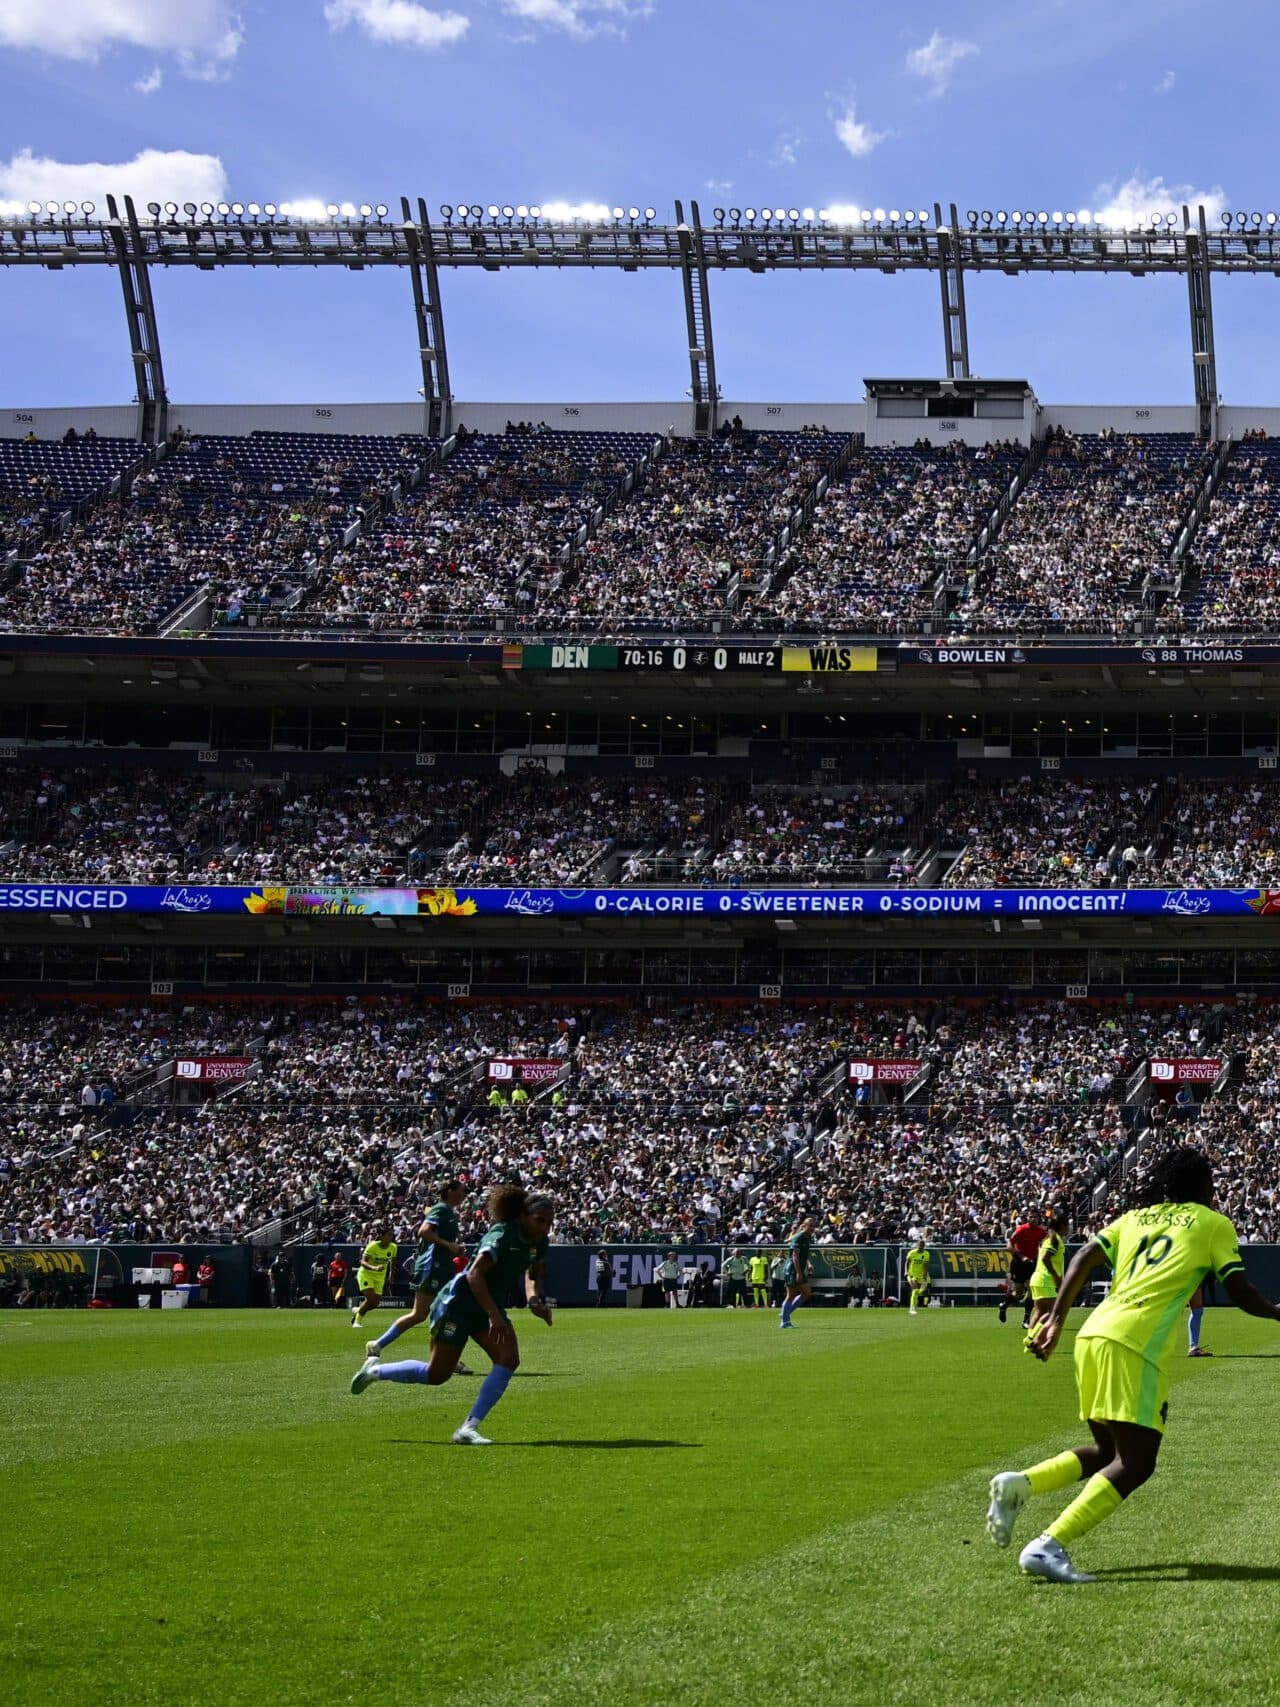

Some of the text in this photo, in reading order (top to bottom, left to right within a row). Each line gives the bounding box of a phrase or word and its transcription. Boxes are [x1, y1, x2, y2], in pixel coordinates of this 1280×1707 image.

[564, 407, 579, 415] 506
[767, 407, 781, 415] 507
[16, 413, 33, 423] 504
[940, 421, 956, 430] 508
[551, 646, 589, 669] DEN
[624, 650, 663, 666] 70:16
[673, 648, 687, 670] 0
[714, 648, 728, 670] 0
[739, 651, 775, 666] HALF 2
[808, 648, 852, 671] WAS
[938, 650, 1006, 662] BOWLEN
[1161, 649, 1243, 661] 88 THOMAS
[198, 751, 217, 760] 306
[416, 754, 435, 764] 307
[1042, 759, 1059, 767] 310
[1259, 758, 1277, 767] 311
[0, 889, 127, 908] ESSENCED
[594, 895, 704, 911] 0-CALORIE
[719, 895, 864, 911] 0-SWEETENER
[879, 895, 981, 911] 0-SODIUM
[153, 984, 172, 993] 103
[449, 986, 469, 995] 104
[761, 987, 779, 996] 105
[1068, 987, 1086, 996] 106
[877, 1069, 920, 1079] DENVER
[1178, 1069, 1220, 1079] DENVER
